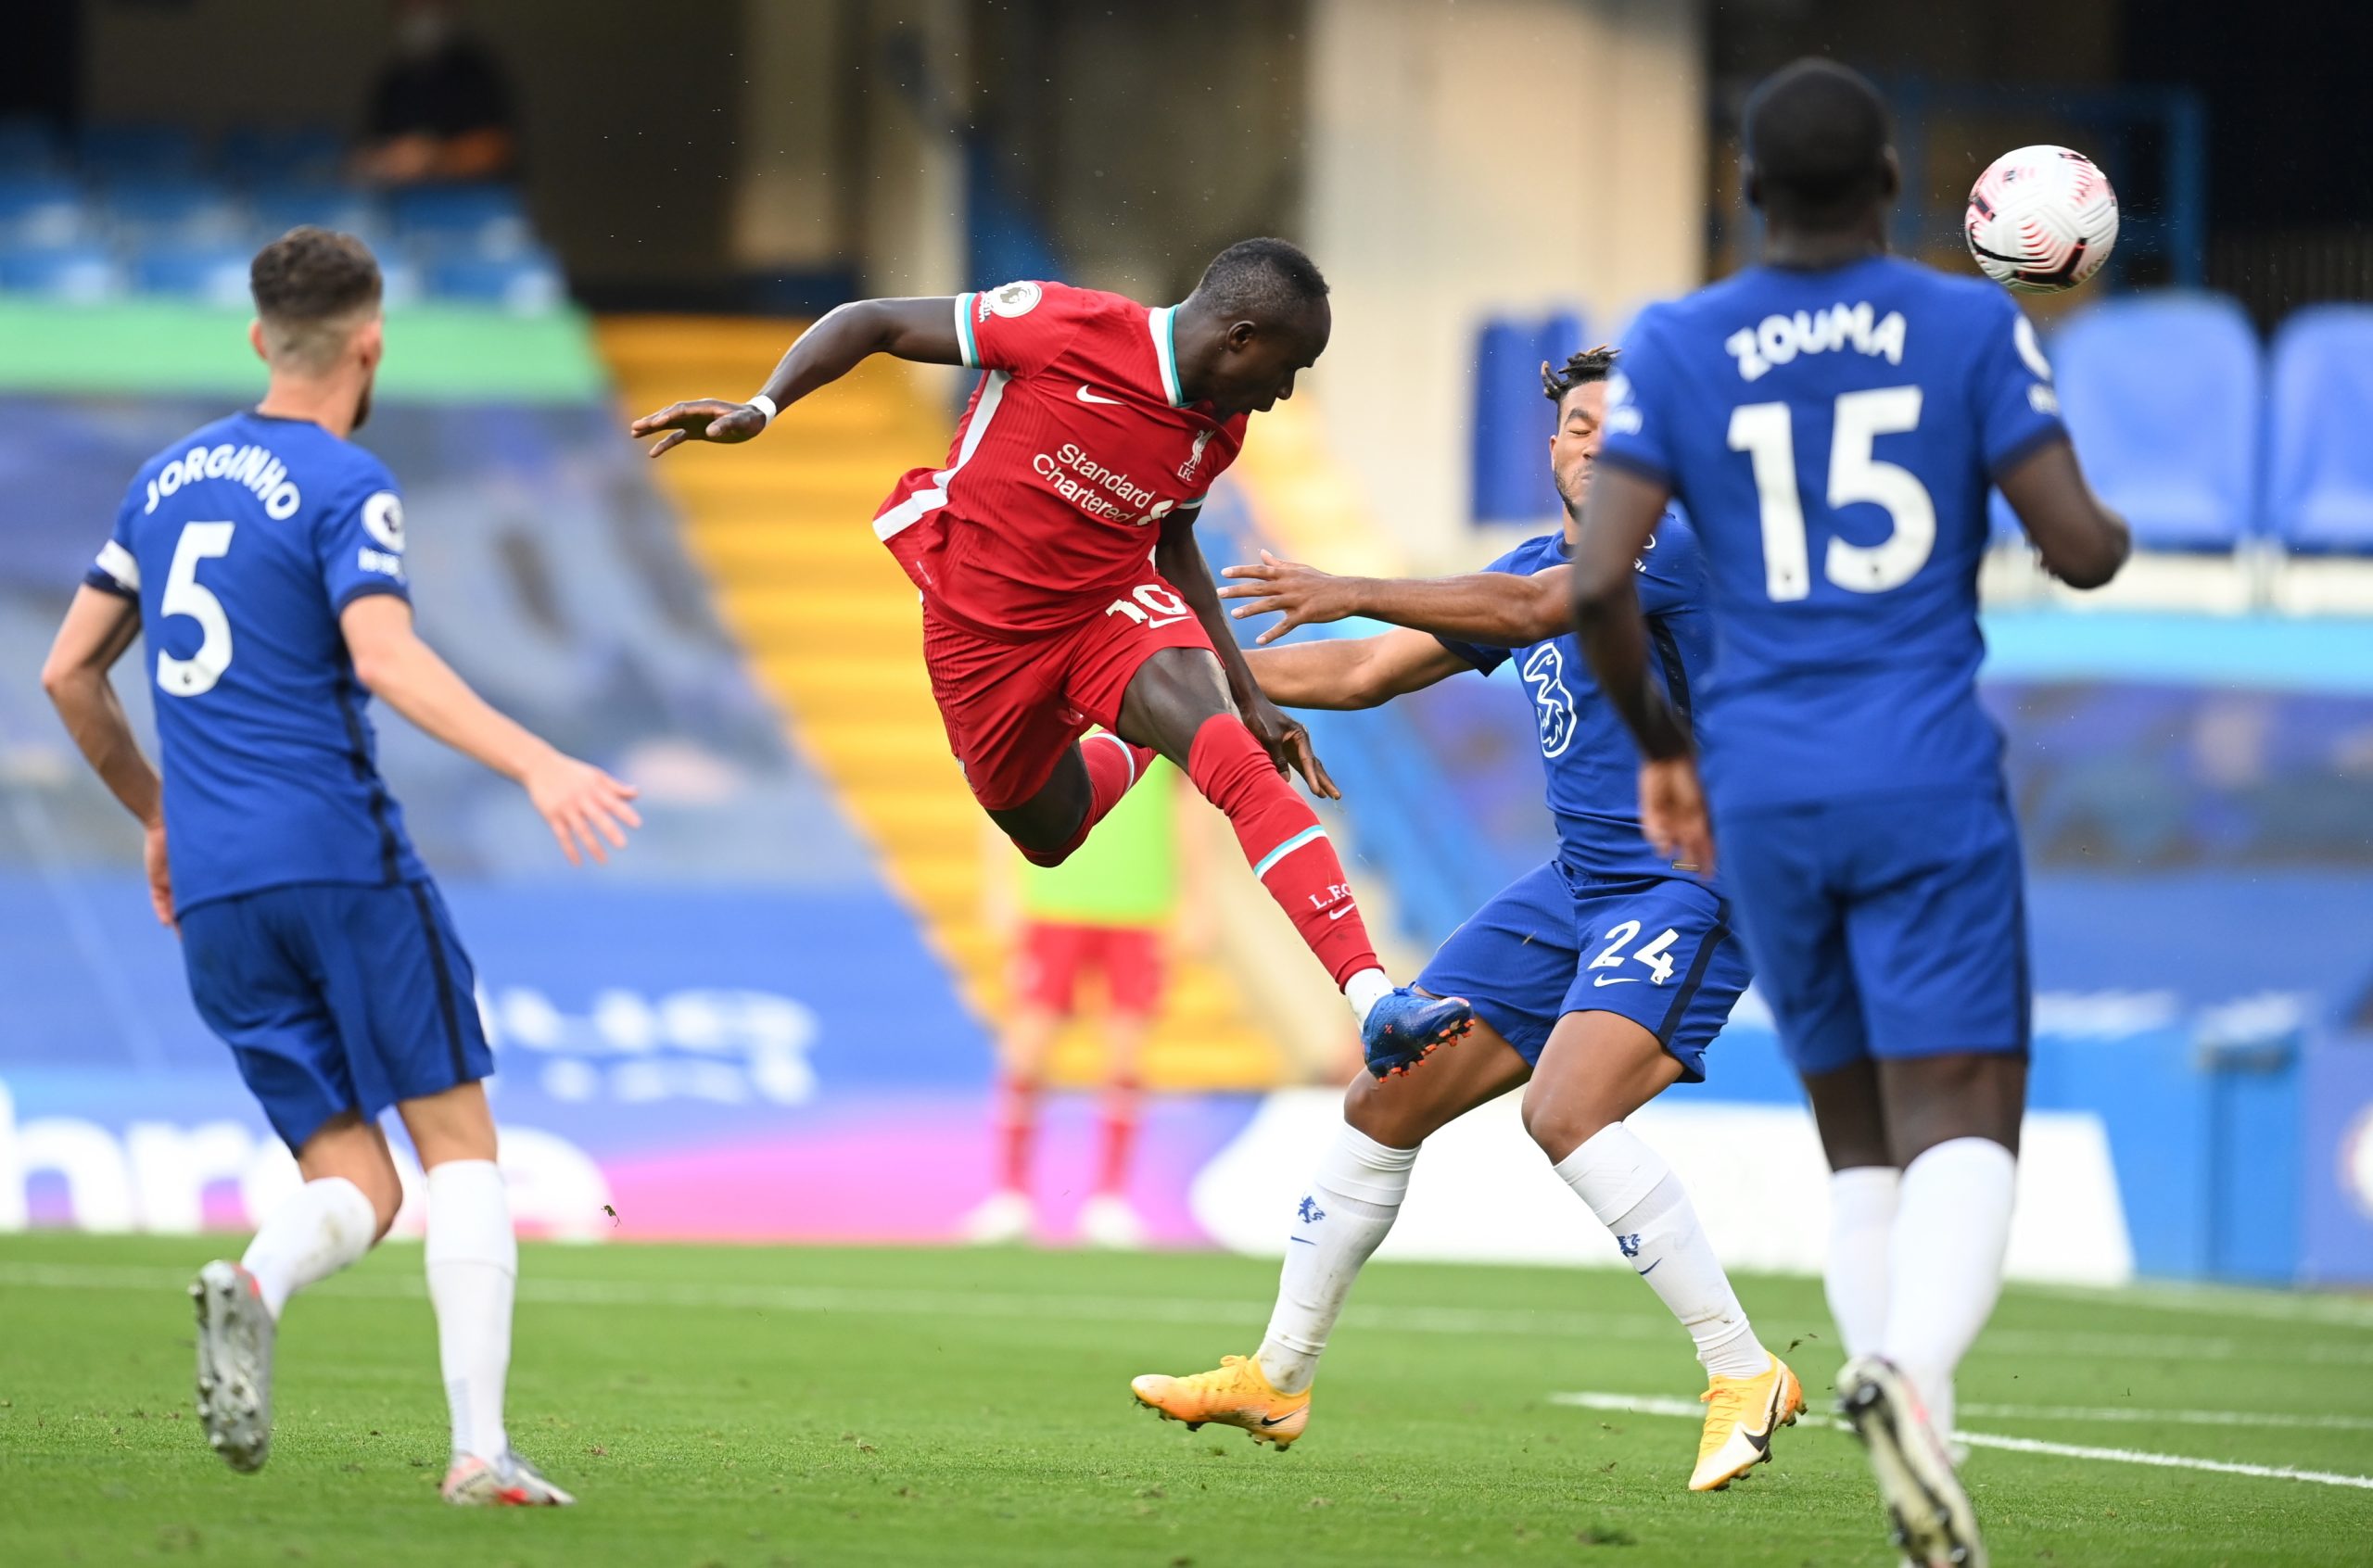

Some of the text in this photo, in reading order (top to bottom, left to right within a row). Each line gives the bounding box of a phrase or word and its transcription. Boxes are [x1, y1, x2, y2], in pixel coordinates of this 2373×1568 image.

[1725, 301, 1907, 382] ZOUMA
[145, 444, 300, 520] JORGINHO
[1033, 453, 1136, 524] Chartered
[1057, 443, 1155, 509] Standard
[1177, 464, 1195, 482] LFC
[1728, 384, 1936, 602] 15
[157, 521, 235, 697] 5
[1105, 584, 1187, 624] 10
[1588, 920, 1680, 985] 24
